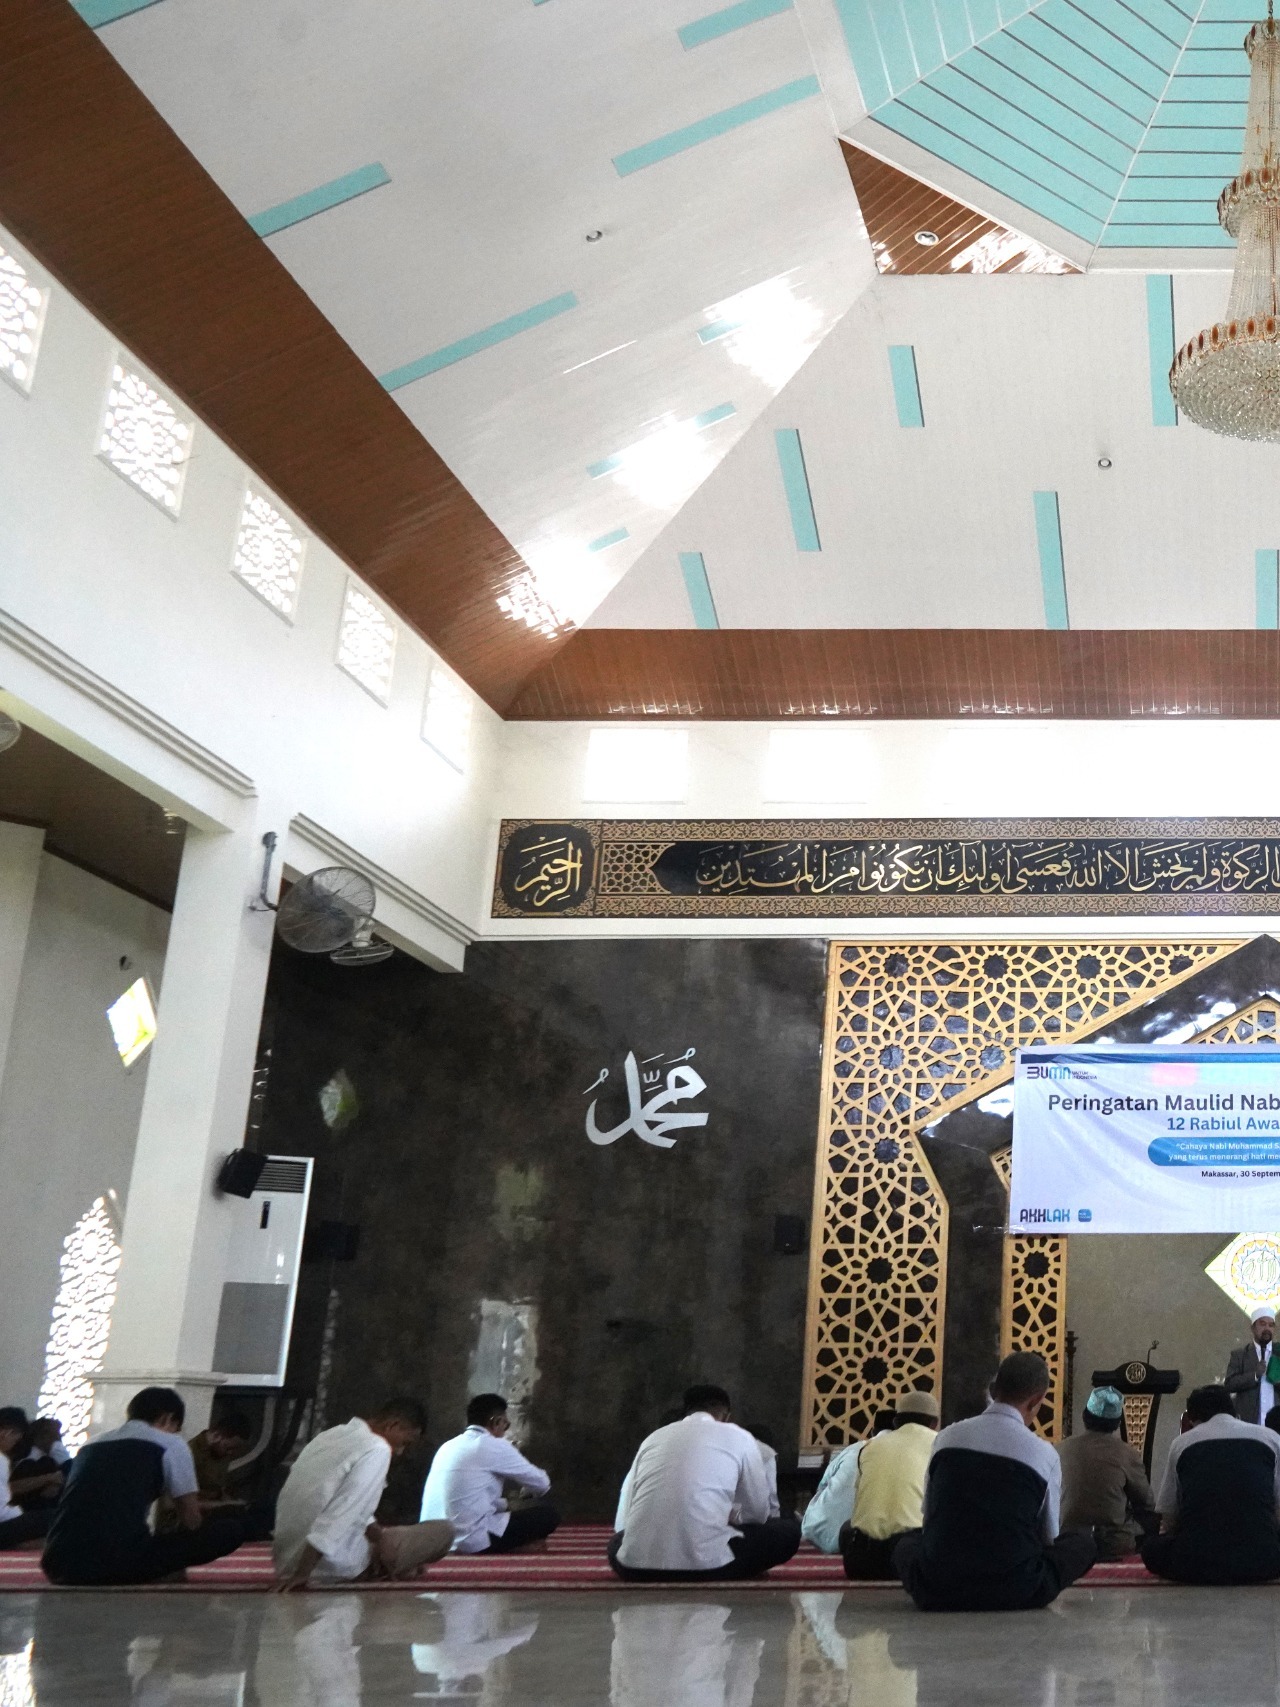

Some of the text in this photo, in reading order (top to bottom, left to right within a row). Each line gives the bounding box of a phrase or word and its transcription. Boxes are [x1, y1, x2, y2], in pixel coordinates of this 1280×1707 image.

[582, 1047, 709, 1151] محمد
[1048, 1094, 1159, 1115] Peringatan
[1165, 1094, 1234, 1111] Maulid
[1167, 1117, 1186, 1131] 12
[1190, 1117, 1242, 1130] Rabiul
[1209, 1142, 1227, 1150] Nabi
[1228, 1142, 1273, 1150] Muhammad
[1168, 1154, 1187, 1162] yang
[1209, 1152, 1249, 1162] menerangi
[1251, 1152, 1266, 1160] hati
[1201, 1170, 1239, 1179] Makassar,
[1240, 1170, 1250, 1178] 30
[1020, 1208, 1070, 1223] AKHLAK
